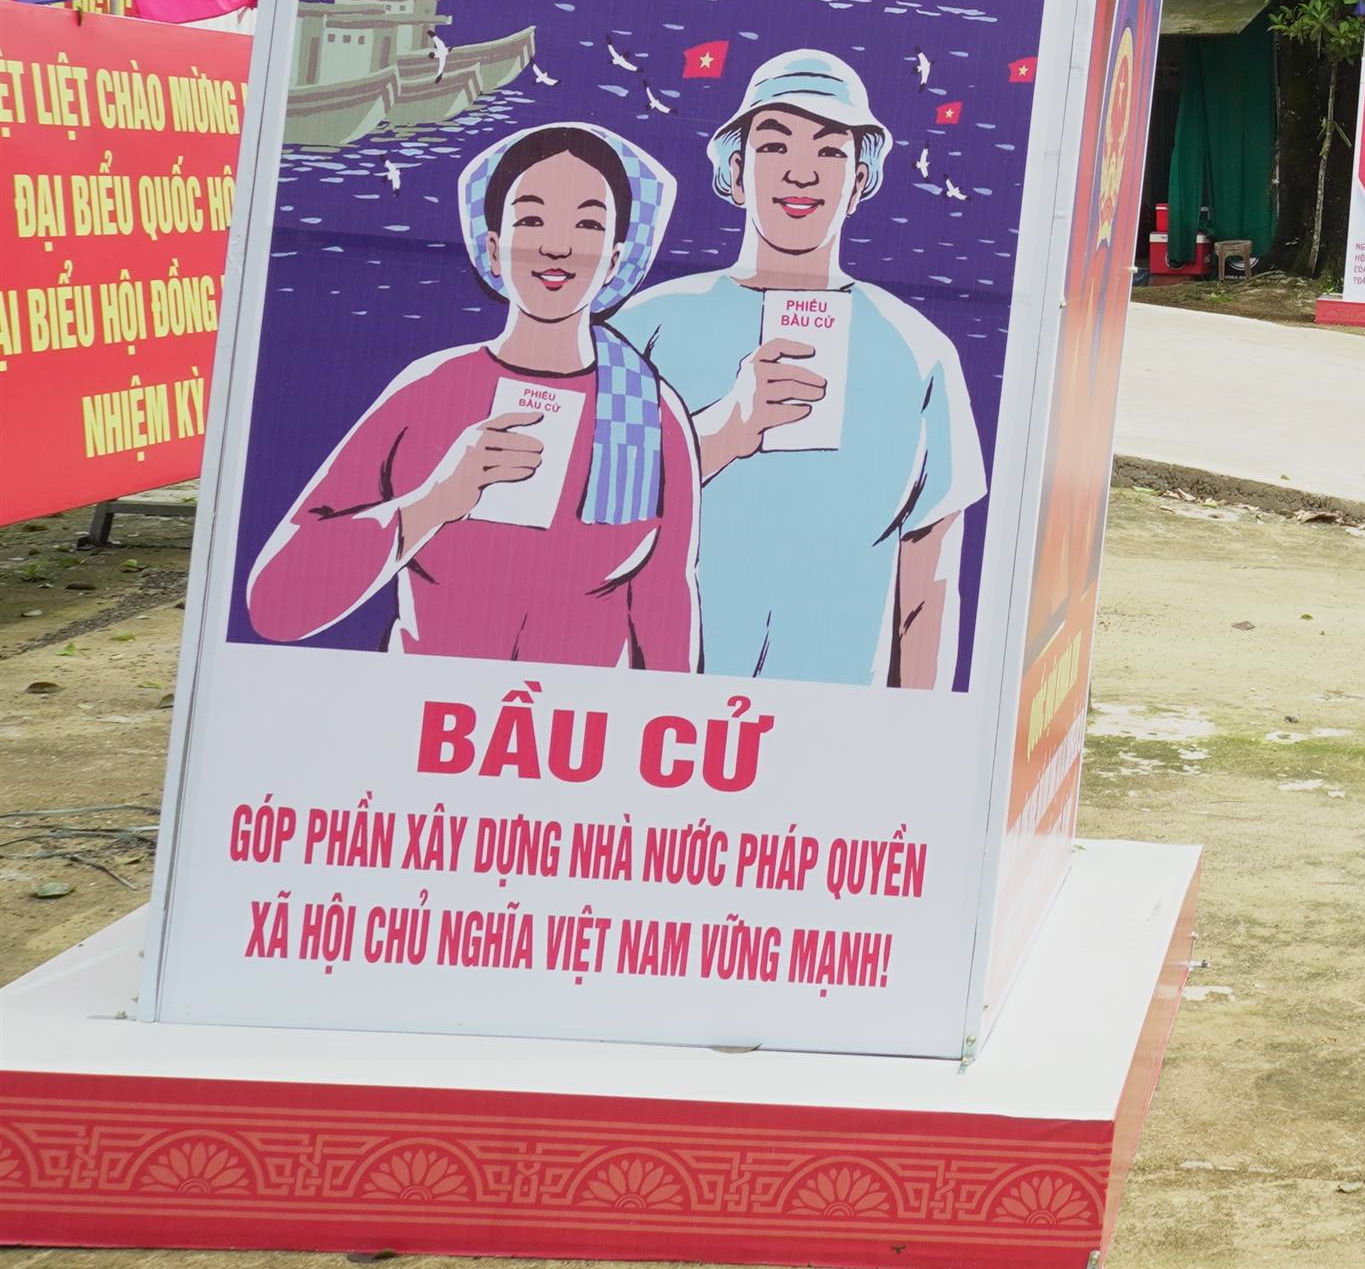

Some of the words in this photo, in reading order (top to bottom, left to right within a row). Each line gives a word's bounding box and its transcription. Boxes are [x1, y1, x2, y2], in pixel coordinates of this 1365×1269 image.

[31, 51, 91, 140] LIỆT
[96, 59, 165, 132] CHÀO
[168, 66, 240, 135] MỪNG
[13, 174, 66, 252] ĐẠI
[71, 150, 134, 236] BIỂU
[138, 156, 203, 241] QUỐC
[27, 260, 95, 353] BIỂU
[100, 269, 147, 355] HỘI
[150, 258, 218, 339] ĐỒNG
[780, 313, 811, 328] BẦU
[814, 314, 836, 329] CỬ
[785, 299, 828, 314] PHIẾU
[81, 375, 171, 462] NHIỆM
[174, 366, 205, 439] KỲ
[518, 396, 541, 412] BẦU
[544, 400, 562, 414] CỬ
[523, 387, 557, 402] PHIẾU
[417, 680, 608, 783] BẦU
[639, 695, 775, 793] CỬ
[230, 793, 297, 863] GÓP
[304, 790, 396, 868] PHẦN
[401, 802, 468, 872] XÂY
[474, 814, 562, 887] DỰNG
[569, 813, 632, 881] NHÀ
[642, 818, 729, 887] NƯỚC
[736, 823, 819, 891] PHÁP
[826, 823, 928, 900] QUYỀN
[244, 890, 291, 959] XÃ
[299, 892, 357, 974] HỘI
[364, 888, 431, 965] CHỦ
[437, 901, 533, 969] NGHĨA
[546, 904, 612, 985] VIỆT
[616, 918, 692, 977] NAM
[700, 913, 781, 982] VỮNG
[788, 929, 893, 998] MẠNH!
